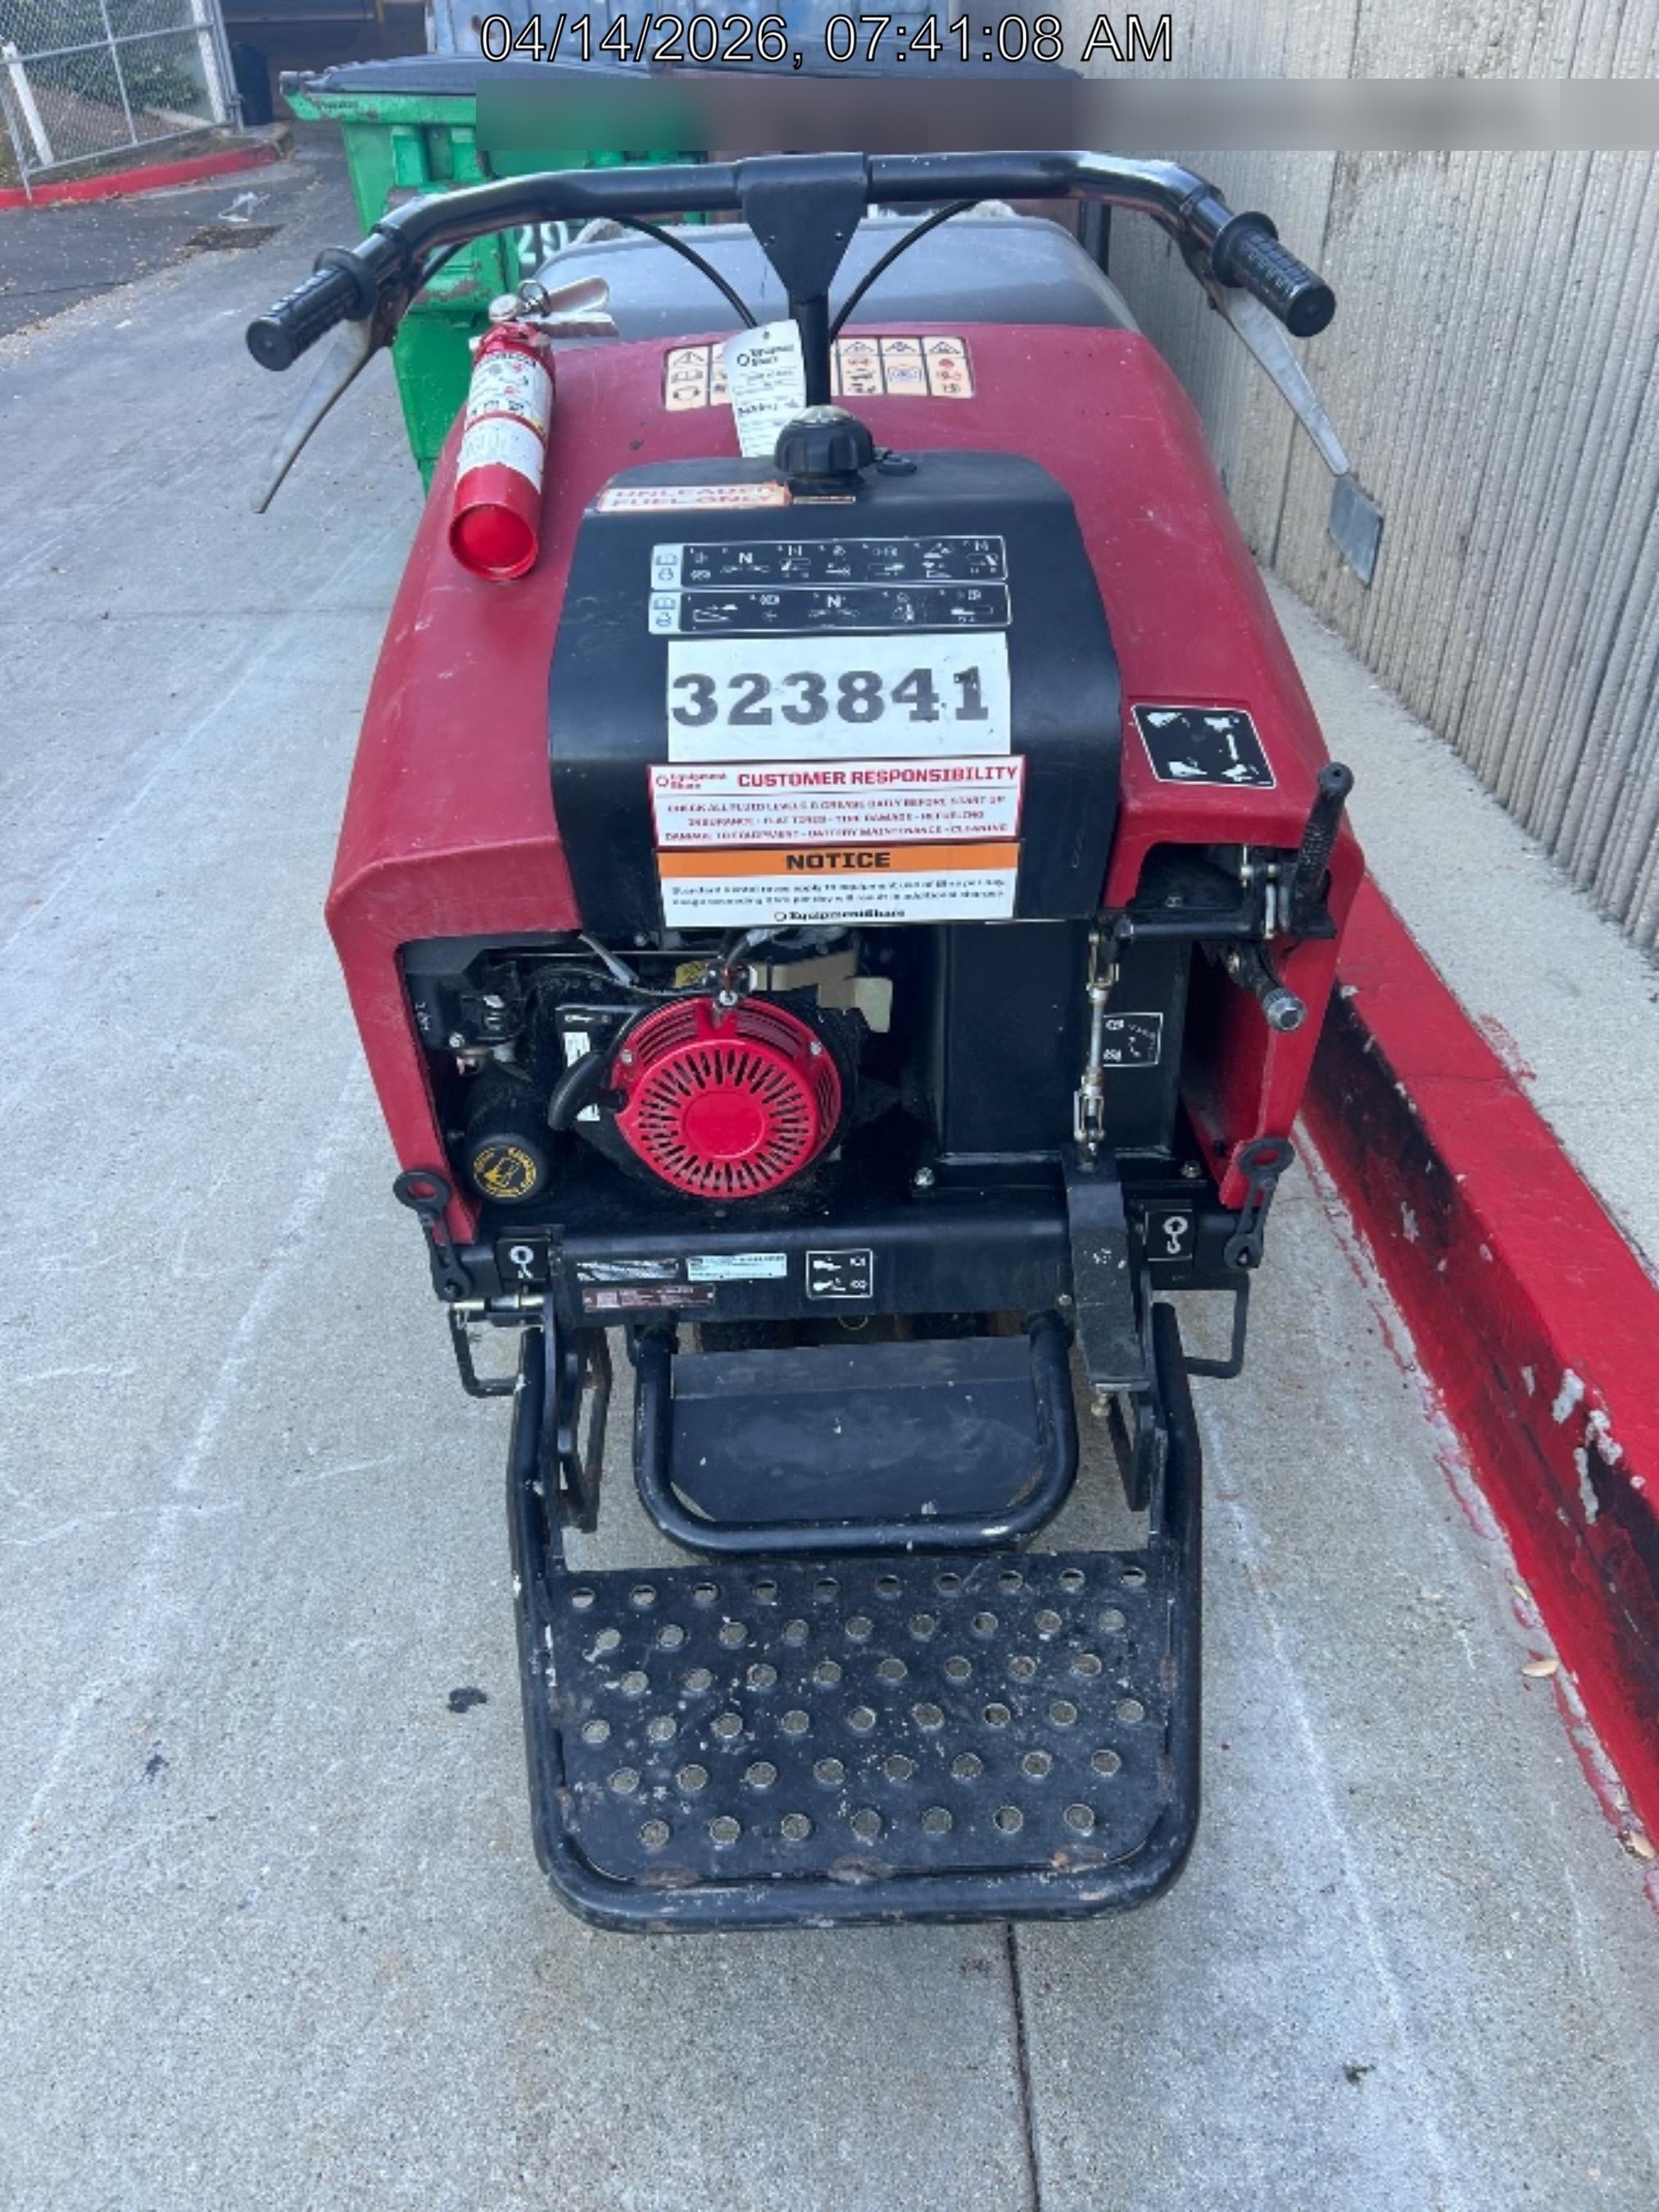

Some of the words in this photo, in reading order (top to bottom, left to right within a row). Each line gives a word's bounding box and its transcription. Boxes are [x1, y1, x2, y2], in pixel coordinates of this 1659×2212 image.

[671, 665, 989, 728] 323841
[738, 770, 846, 787] CUSTOMER
[851, 766, 1018, 785] RESPONSIBILITY
[786, 852, 891, 870] NOTICE
